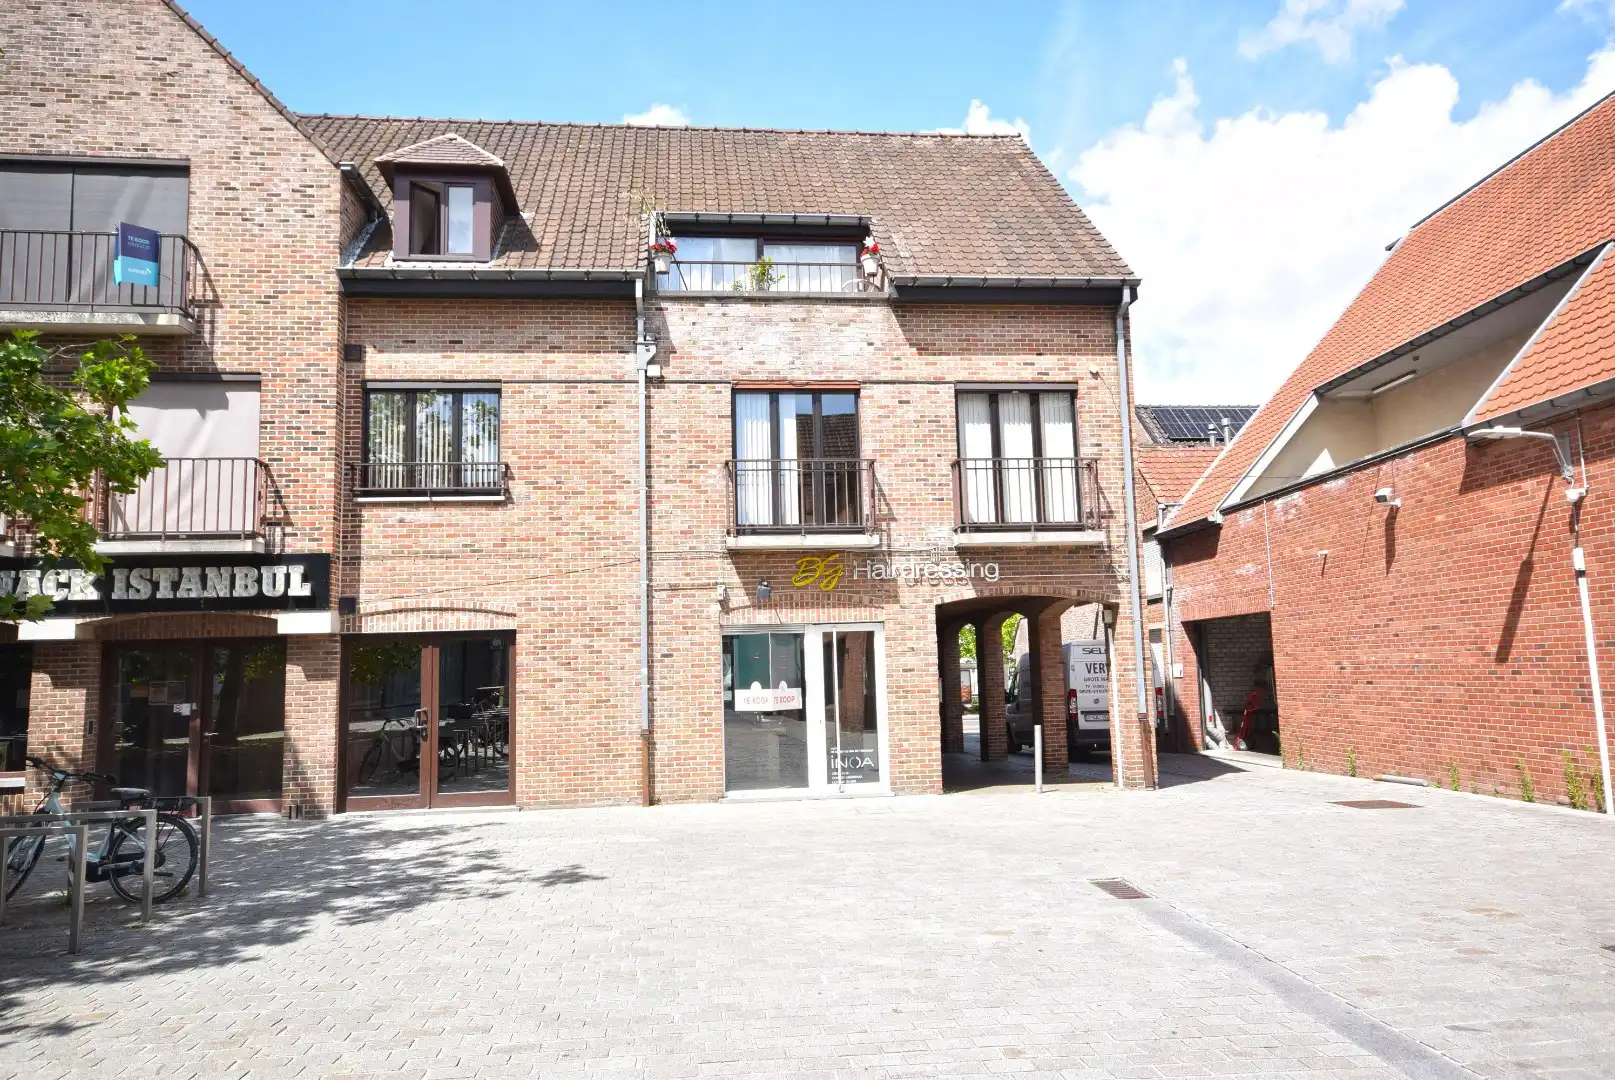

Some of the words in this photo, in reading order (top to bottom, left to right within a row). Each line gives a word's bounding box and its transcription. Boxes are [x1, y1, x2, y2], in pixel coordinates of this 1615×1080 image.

[853, 558, 999, 582] Hairdressing
[111, 565, 312, 600] ISTANBUL
[1082, 647, 1107, 655] SEL
[1085, 662, 1108, 674] VER
[779, 695, 796, 704] KOOP
